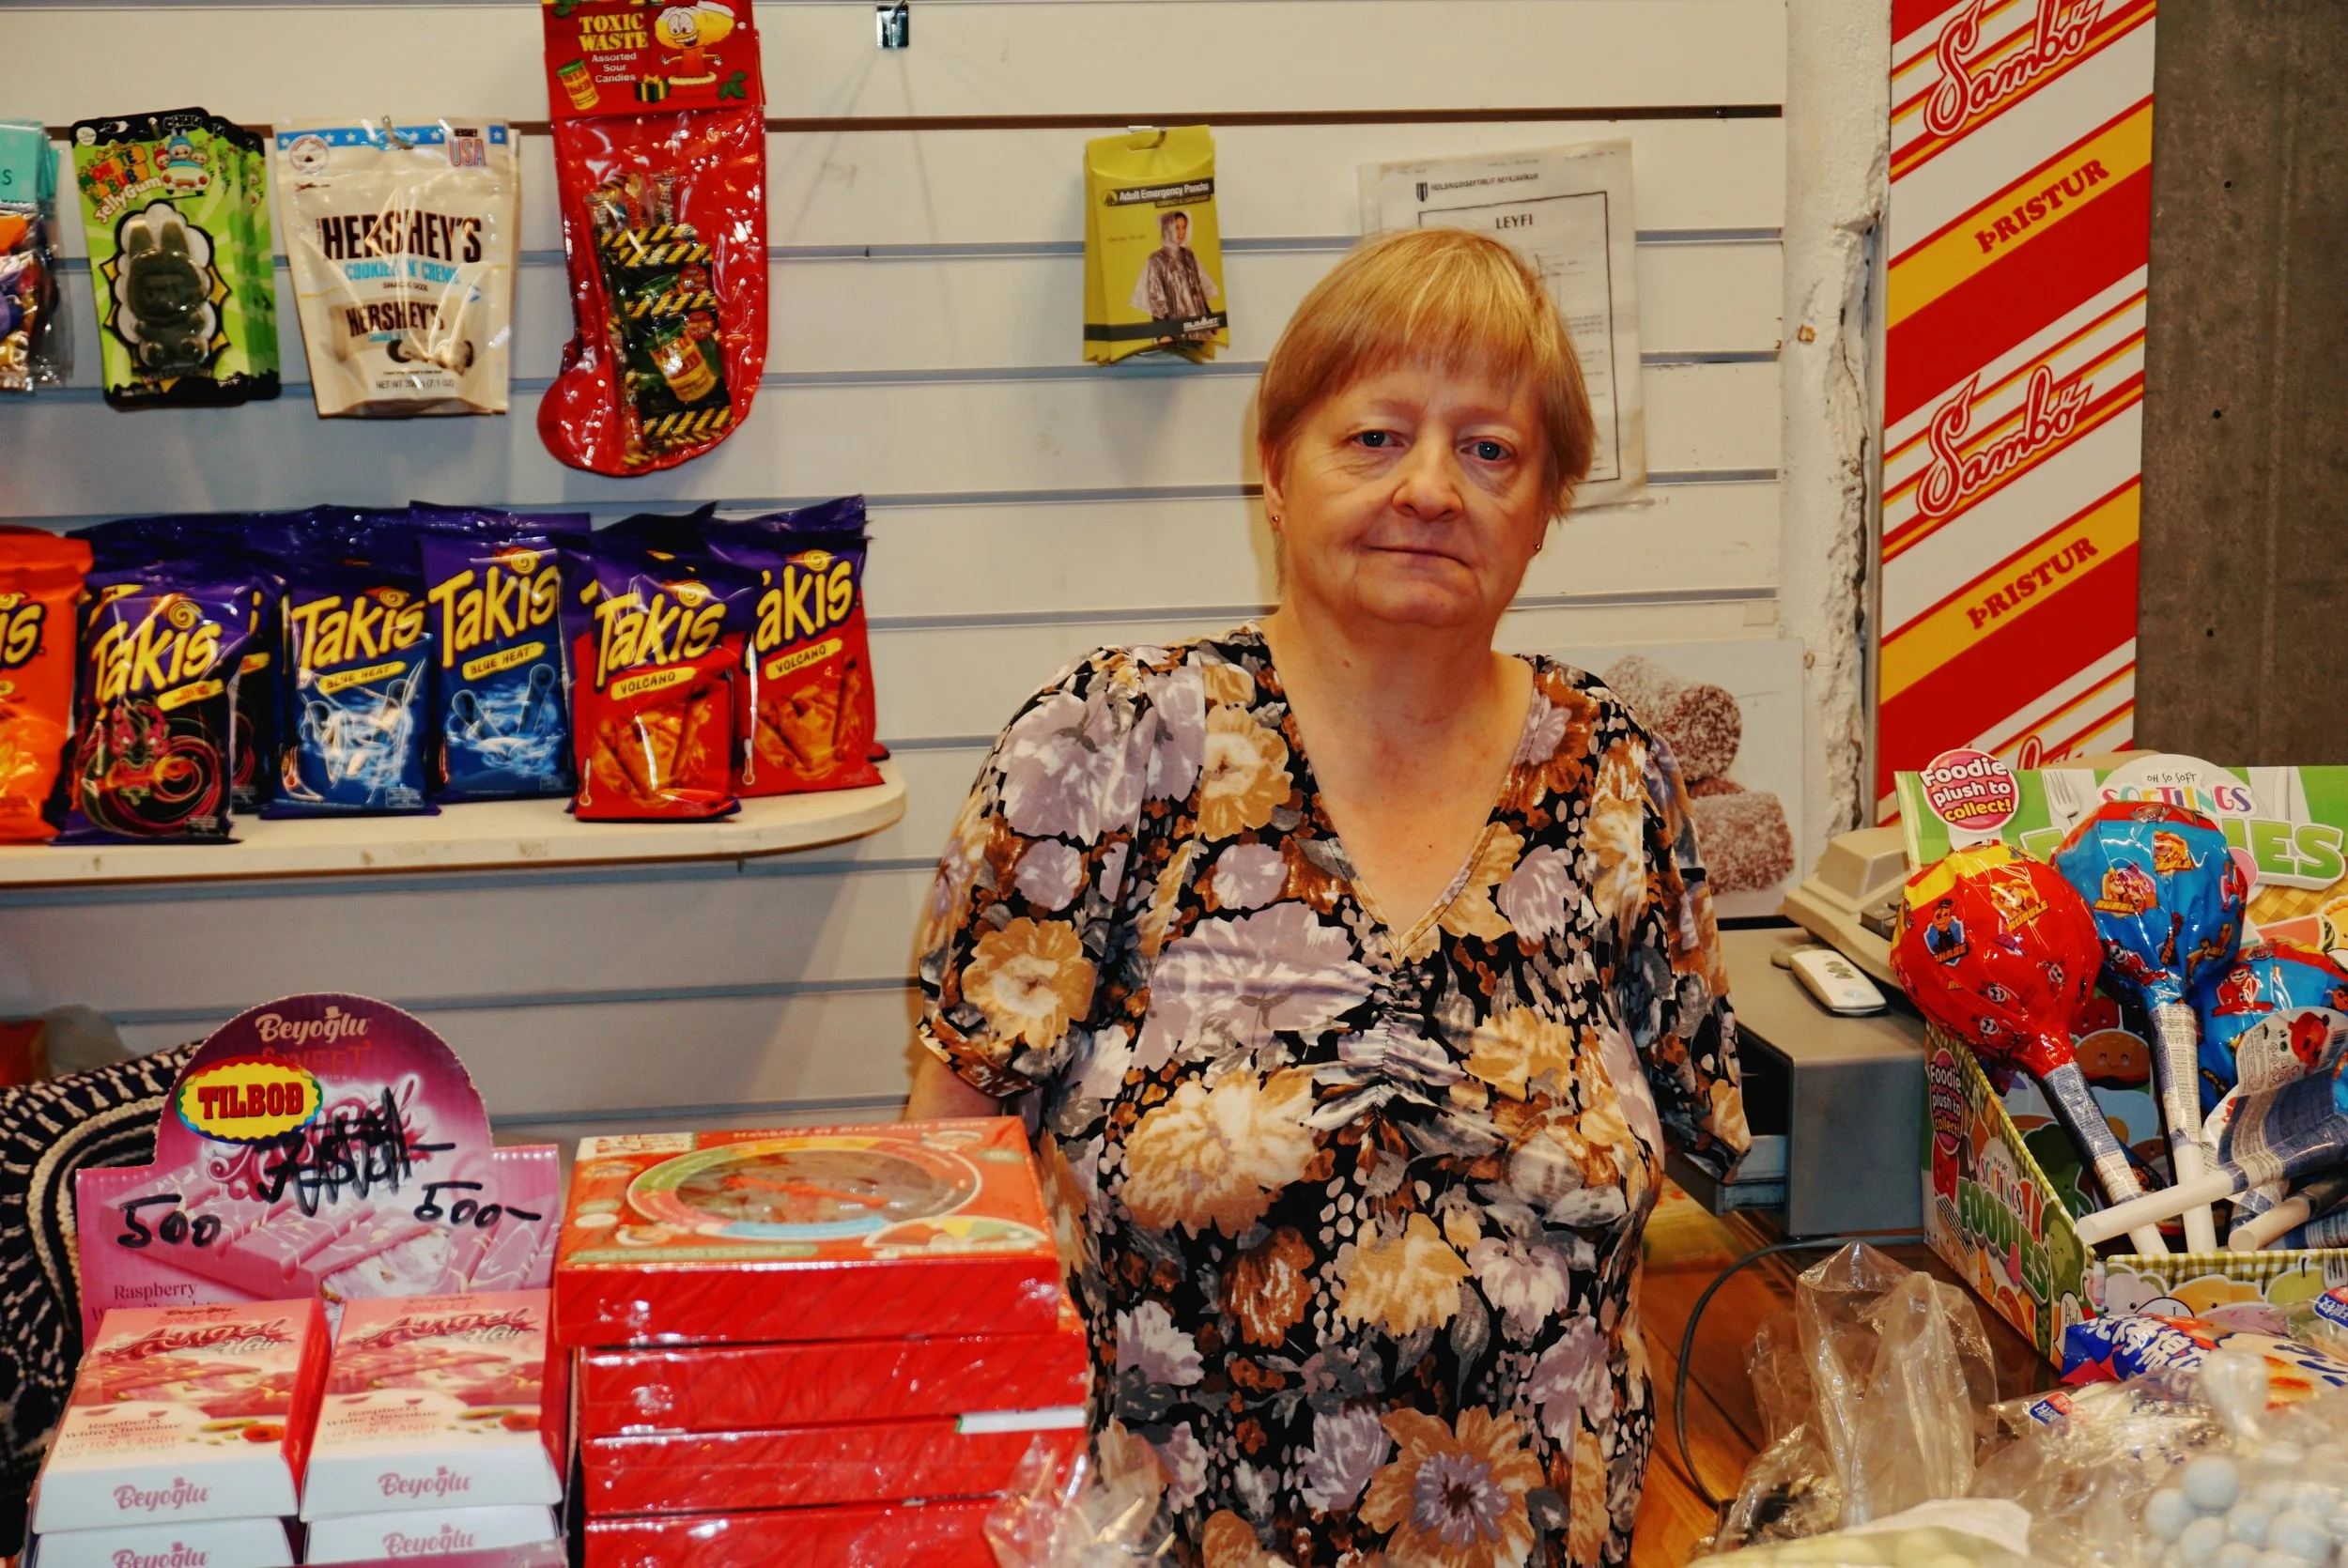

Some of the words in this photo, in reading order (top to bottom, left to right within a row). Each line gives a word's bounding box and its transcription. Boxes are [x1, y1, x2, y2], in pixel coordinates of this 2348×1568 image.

[579, 12, 644, 34] TOXIC
[579, 31, 649, 53] WASTE
[592, 53, 638, 63] Assorted
[603, 64, 626, 72] Sour
[1923, 0, 2105, 136] Sambo
[595, 73, 637, 83] Candies
[448, 138, 487, 167] USA
[1120, 190, 1139, 201] Adult
[1140, 185, 1183, 199] Emergency
[1184, 182, 1209, 193] Poncho
[1975, 158, 2109, 254] ÞRISTUR
[1496, 214, 1534, 230] LEYFI
[321, 209, 482, 263] HERSHEY'S
[346, 301, 445, 337] HERSHEY'S
[1183, 315, 1219, 329] SUMMIT
[1916, 364, 2093, 518] Sambo
[1966, 535, 2099, 630] ÞRISTUR
[746, 560, 853, 669] akis
[471, 660, 497, 674] BLUE
[502, 649, 530, 665] HEAT
[775, 645, 827, 672] VOLCANO
[326, 675, 354, 689] BLUE
[361, 664, 391, 678] HEAT
[620, 671, 675, 695] VOLCANO
[1919, 757, 2009, 788] Foodie
[2147, 775, 2159, 783] OH
[2162, 773, 2172, 783] SO
[2175, 773, 2197, 783] SOFT
[1933, 781, 1985, 807] plush
[1988, 781, 2012, 795] to
[1944, 798, 2014, 822] collect!
[255, 1006, 370, 1044] Beyoğlu
[1930, 1062, 1962, 1094] Foodie
[1932, 1091, 1953, 1111] plush
[1954, 1099, 1961, 1117] to
[1935, 1115, 1960, 1139] collect!
[117, 1193, 222, 1248] 500
[114, 1282, 197, 1302] Raspberry
[66, 1429, 108, 1438] White
[110, 1422, 183, 1434] Chocolate
[88, 1418, 164, 1430] Raspberry
[127, 1436, 178, 1446] CANDY
[114, 1476, 211, 1511] Beyoğlu
[378, 1466, 472, 1498] Beyoğlu
[382, 1523, 478, 1557] Beyoğlu
[112, 1541, 210, 1568] Beyoğlu
